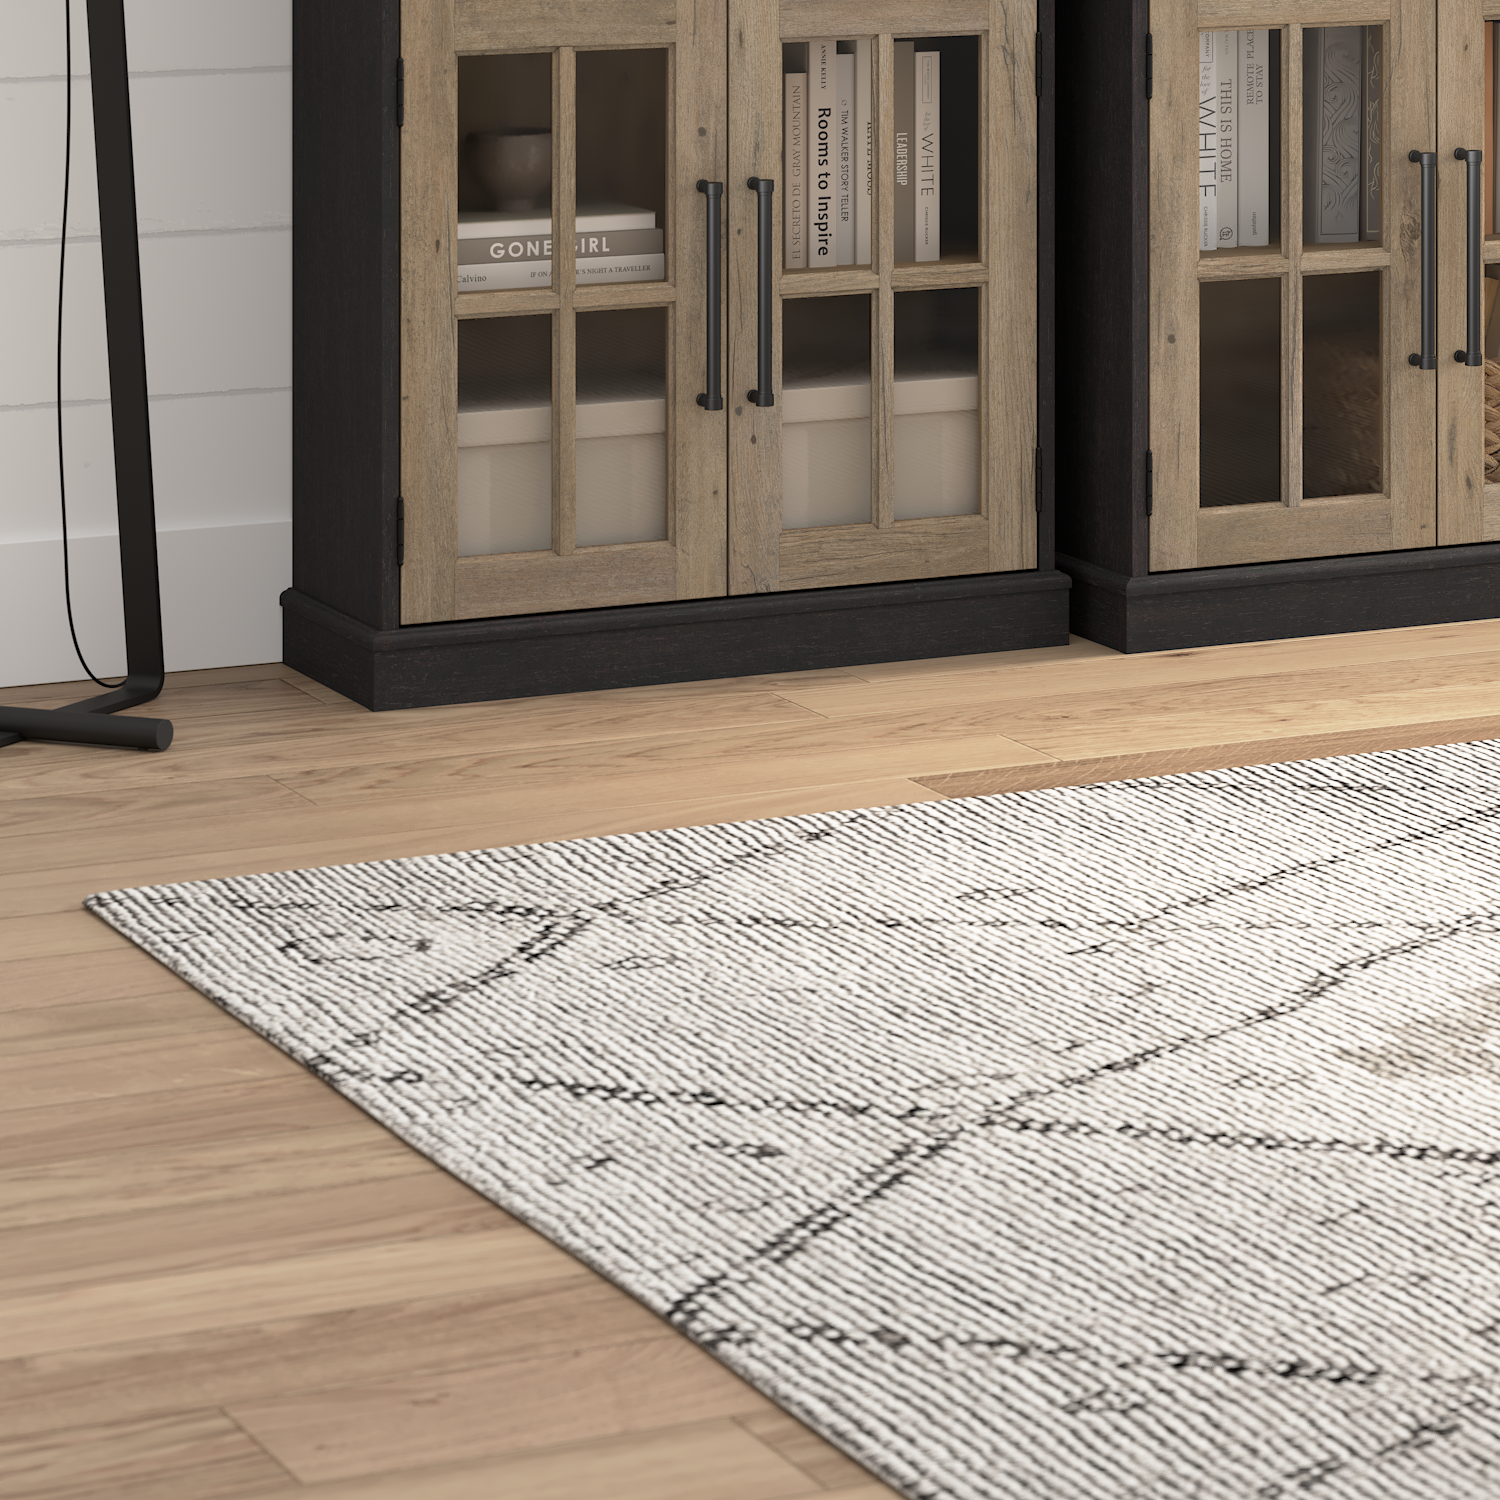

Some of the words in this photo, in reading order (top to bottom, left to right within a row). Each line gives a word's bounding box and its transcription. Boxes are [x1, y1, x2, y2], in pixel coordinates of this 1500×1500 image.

[1246, 62, 1254, 105] REMOTE
[1255, 64, 1263, 89] STAY
[1220, 78, 1233, 115] THIS
[1255, 90, 1263, 105] TO
[792, 85, 801, 146] MOUNTAIN
[841, 110, 849, 126] TIM
[1220, 119, 1233, 133] IS
[818, 107, 832, 167] Rooms
[841, 126, 849, 162] WALKER
[792, 151, 801, 178] GRAY
[896, 132, 908, 186] LEADERSHIP
[921, 132, 934, 196] WHITE
[1220, 137, 1233, 183] HOME
[792, 182, 801, 197] DE
[818, 171, 832, 190] to
[841, 163, 849, 192] STORY
[841, 192, 849, 222] TELLER
[792, 197, 801, 247] SECRETO
[814, 196, 833, 256] Inspire
[489, 239, 552, 259] GONE
[575, 236, 610, 253] IRL
[792, 249, 801, 260] EL
[457, 274, 487, 284] Calvino
[587, 267, 607, 275] NIGHT
[614, 264, 651, 273] TRAVELLER
